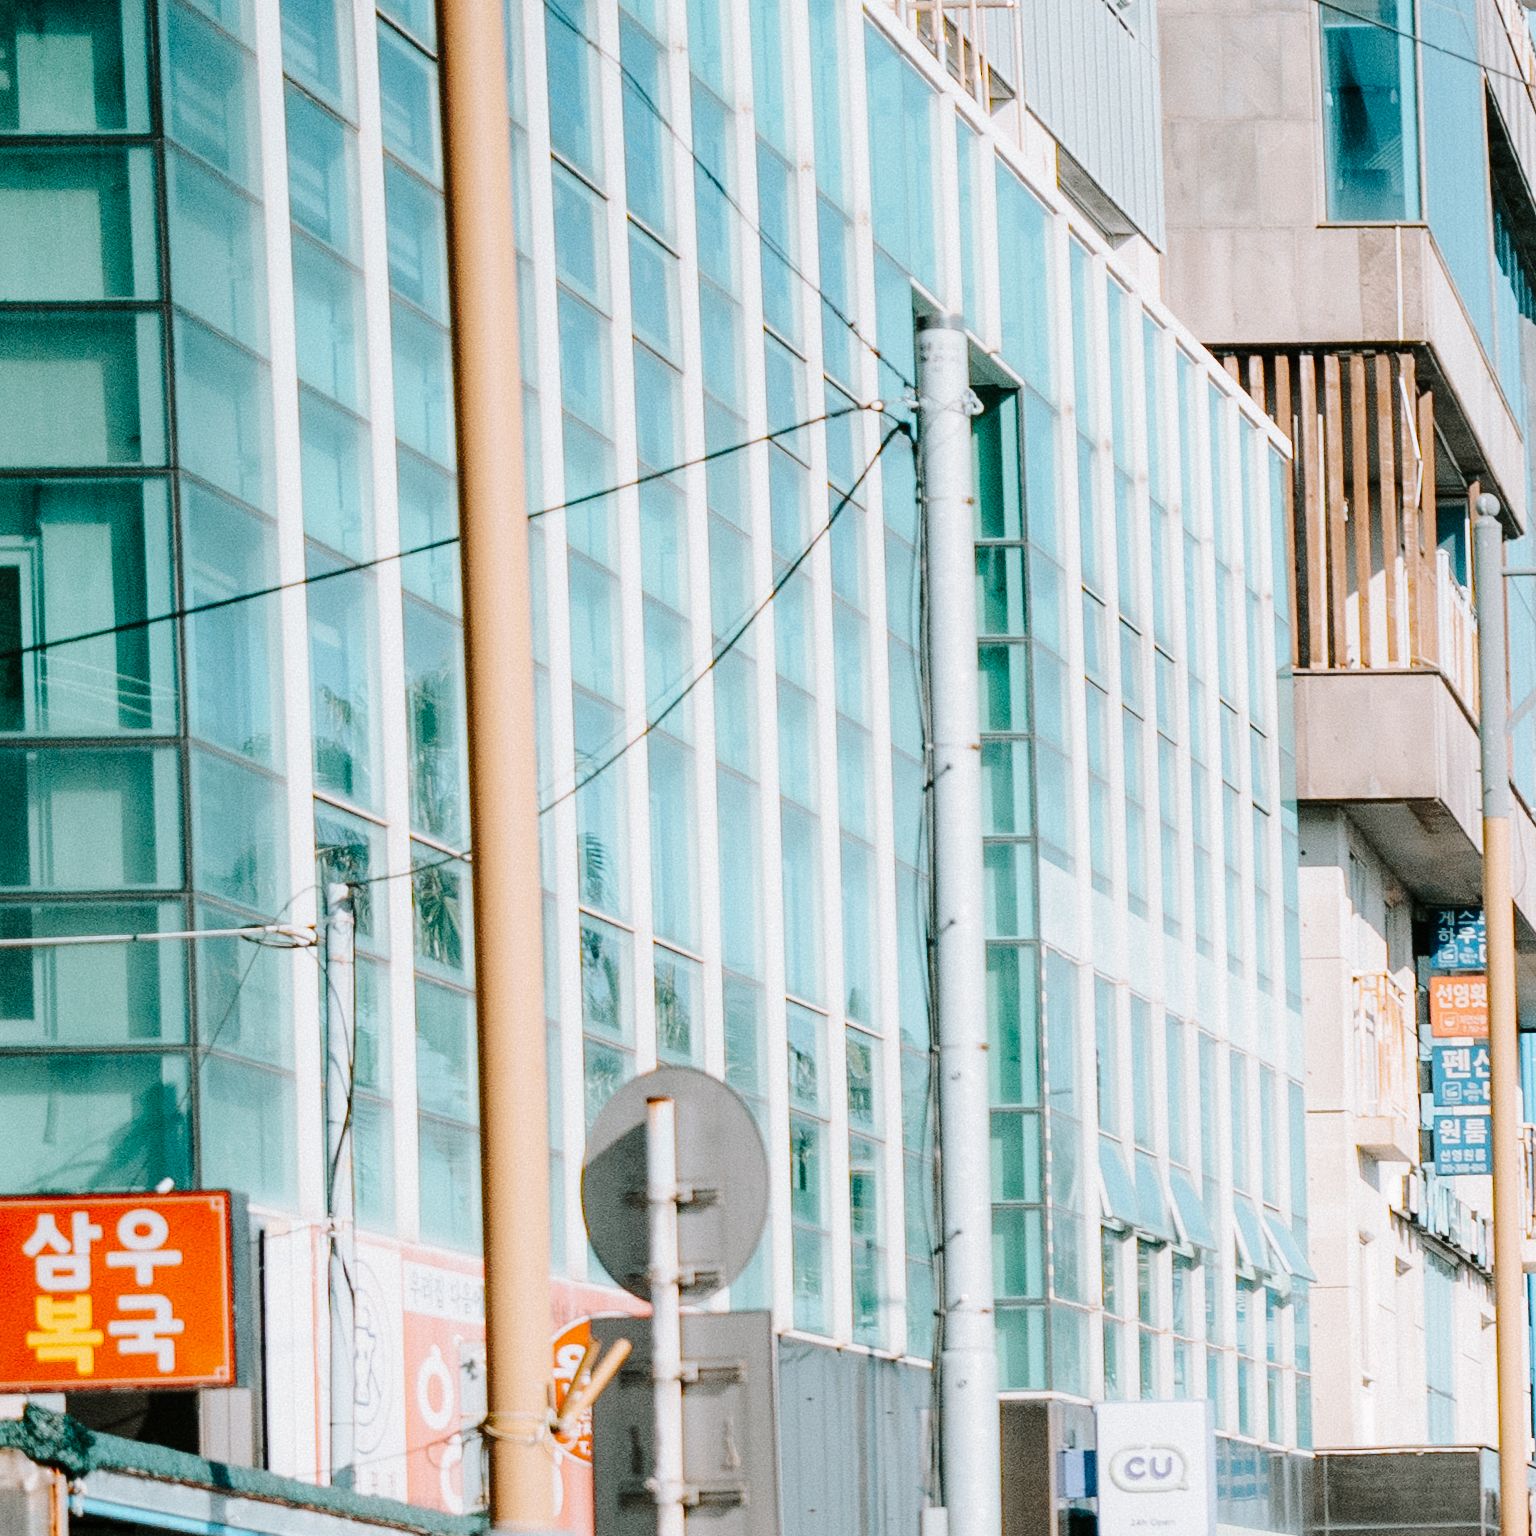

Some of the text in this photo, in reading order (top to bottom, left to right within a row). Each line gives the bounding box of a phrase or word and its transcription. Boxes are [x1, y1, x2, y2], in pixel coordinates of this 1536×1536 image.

[1439, 1118, 1488, 1144] 원룸
[22, 1208, 183, 1292] 삼우
[26, 1294, 185, 1376] 복국
[1124, 1456, 1173, 1480] CU
